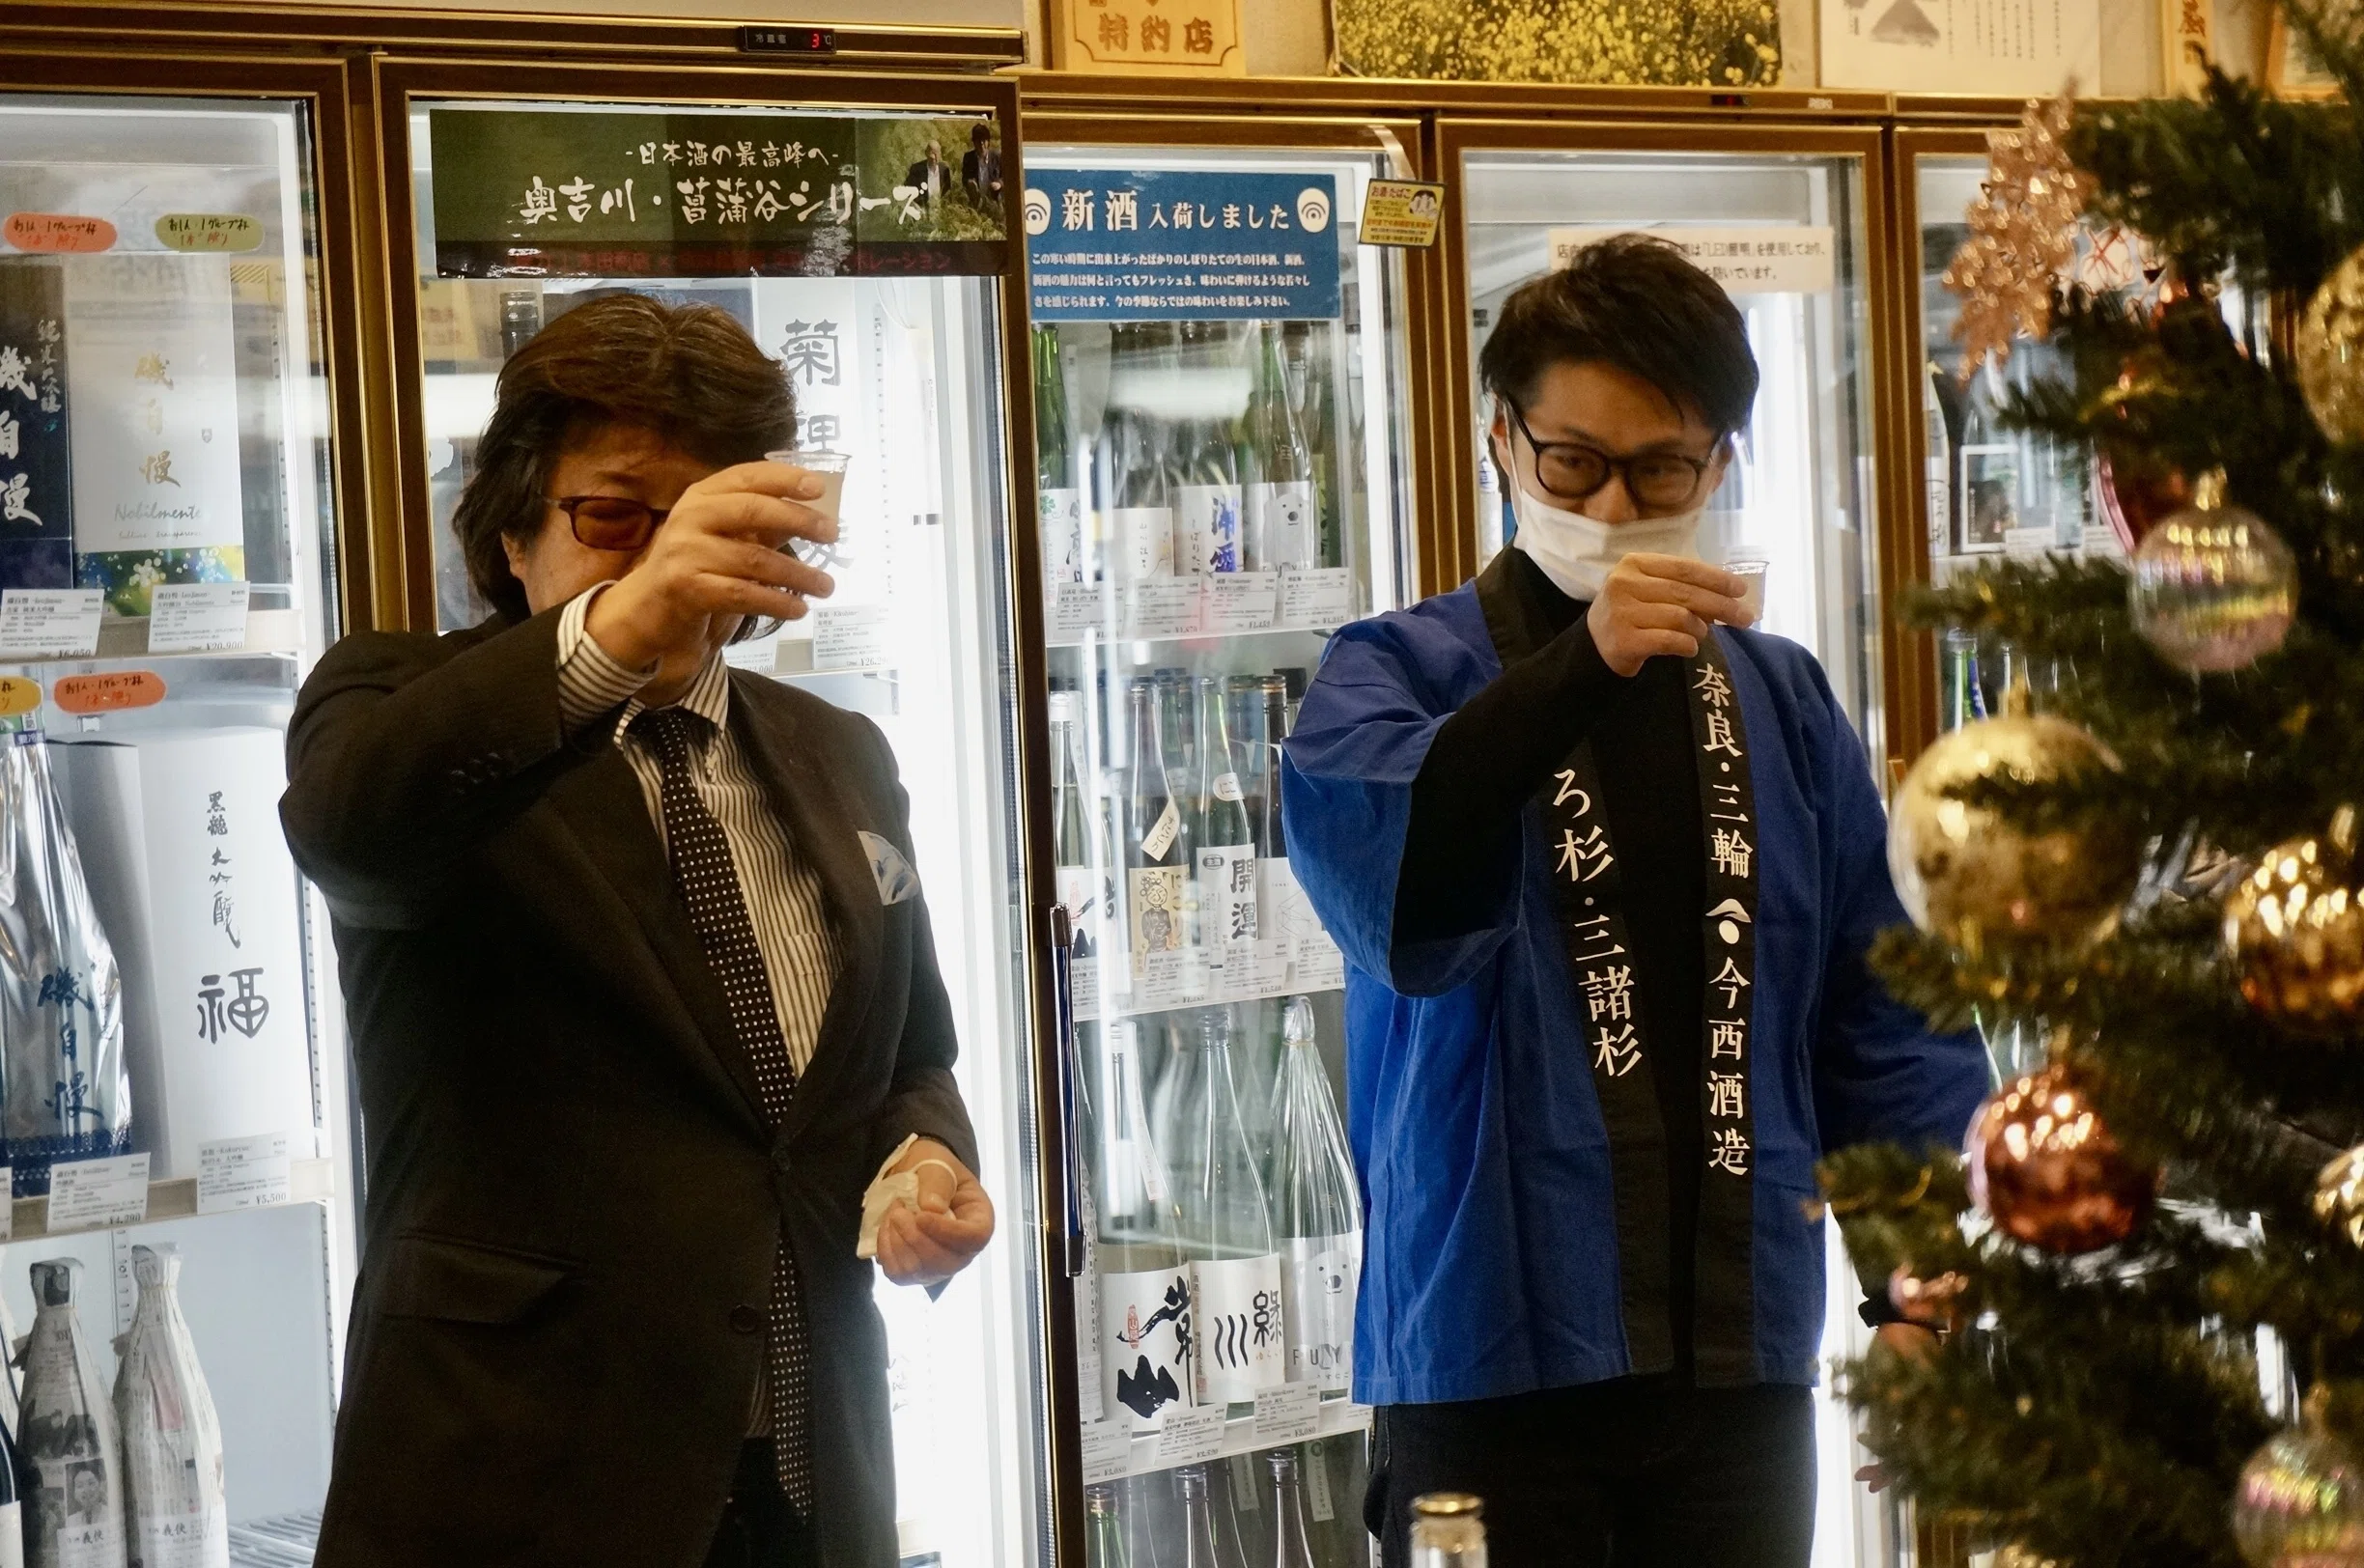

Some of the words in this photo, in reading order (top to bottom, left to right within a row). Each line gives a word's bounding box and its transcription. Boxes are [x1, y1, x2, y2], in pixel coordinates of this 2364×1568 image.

[1098, 13, 1214, 54] 特約店
[1692, 661, 1754, 880] 奈良・三輪
[1229, 856, 1257, 940] 開運
[197, 967, 270, 1045] 福
[1707, 955, 1751, 1175] 今西酒造
[255, 1190, 287, 1206] ¥5,500
